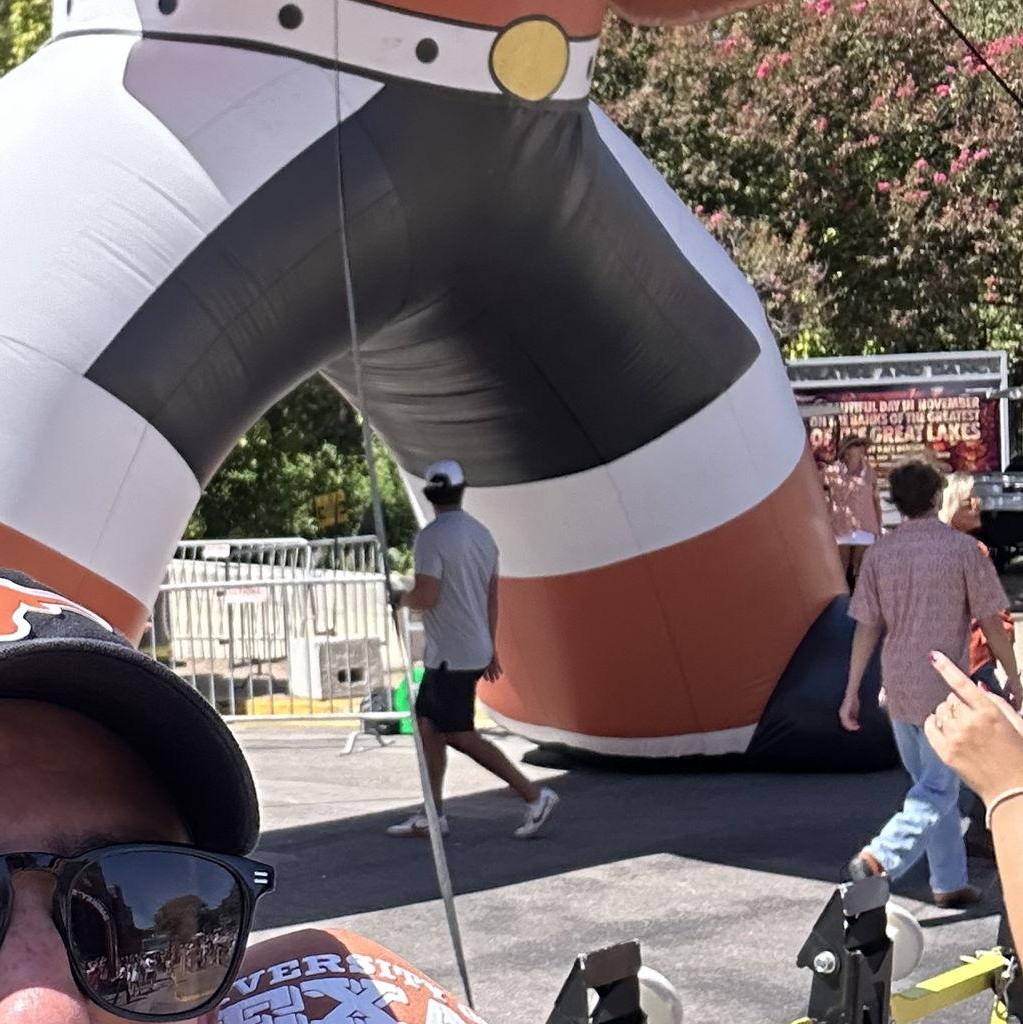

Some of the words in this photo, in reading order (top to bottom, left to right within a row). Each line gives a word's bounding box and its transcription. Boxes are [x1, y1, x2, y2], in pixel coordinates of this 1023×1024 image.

[918, 395, 980, 412] NOVEMBER
[926, 409, 981, 424] GREATEST
[869, 424, 925, 444] GREAT
[926, 421, 982, 445] LAKES
[222, 953, 447, 1004] VERSITY
